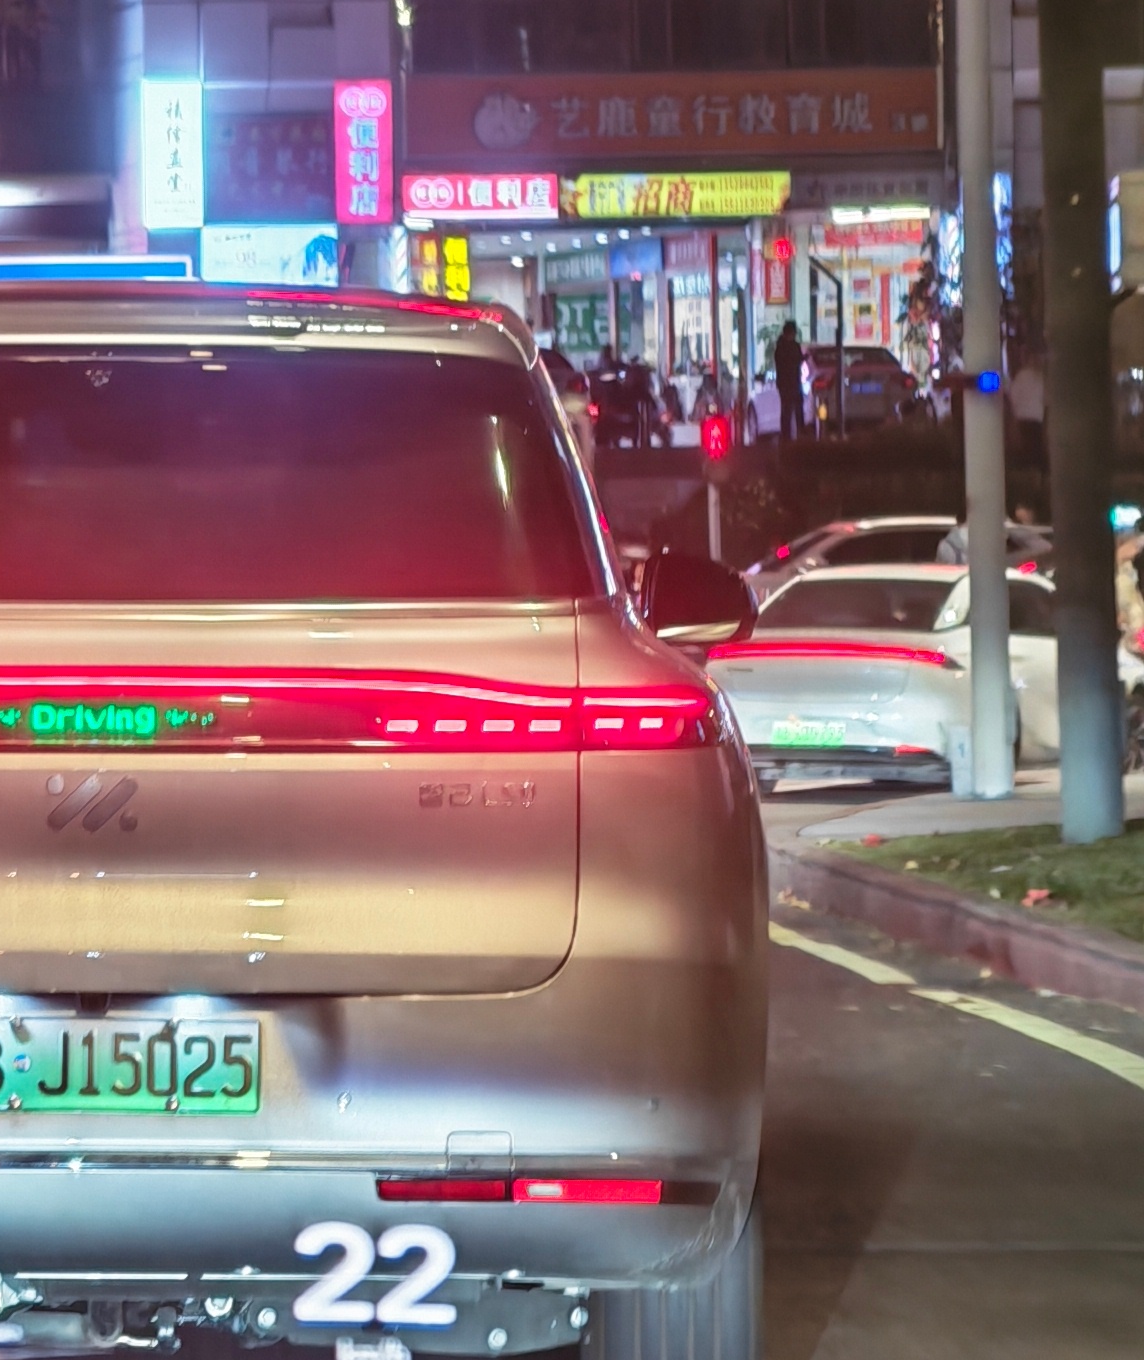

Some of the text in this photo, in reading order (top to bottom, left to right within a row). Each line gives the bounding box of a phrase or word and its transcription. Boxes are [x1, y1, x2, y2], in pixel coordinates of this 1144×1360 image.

[550, 92, 872, 139] 艺鹿童行教育城
[347, 117, 379, 216] 便利店
[468, 177, 551, 208] 便利店
[31, 703, 156, 734] Driving
[292, 1220, 458, 1324] 22
